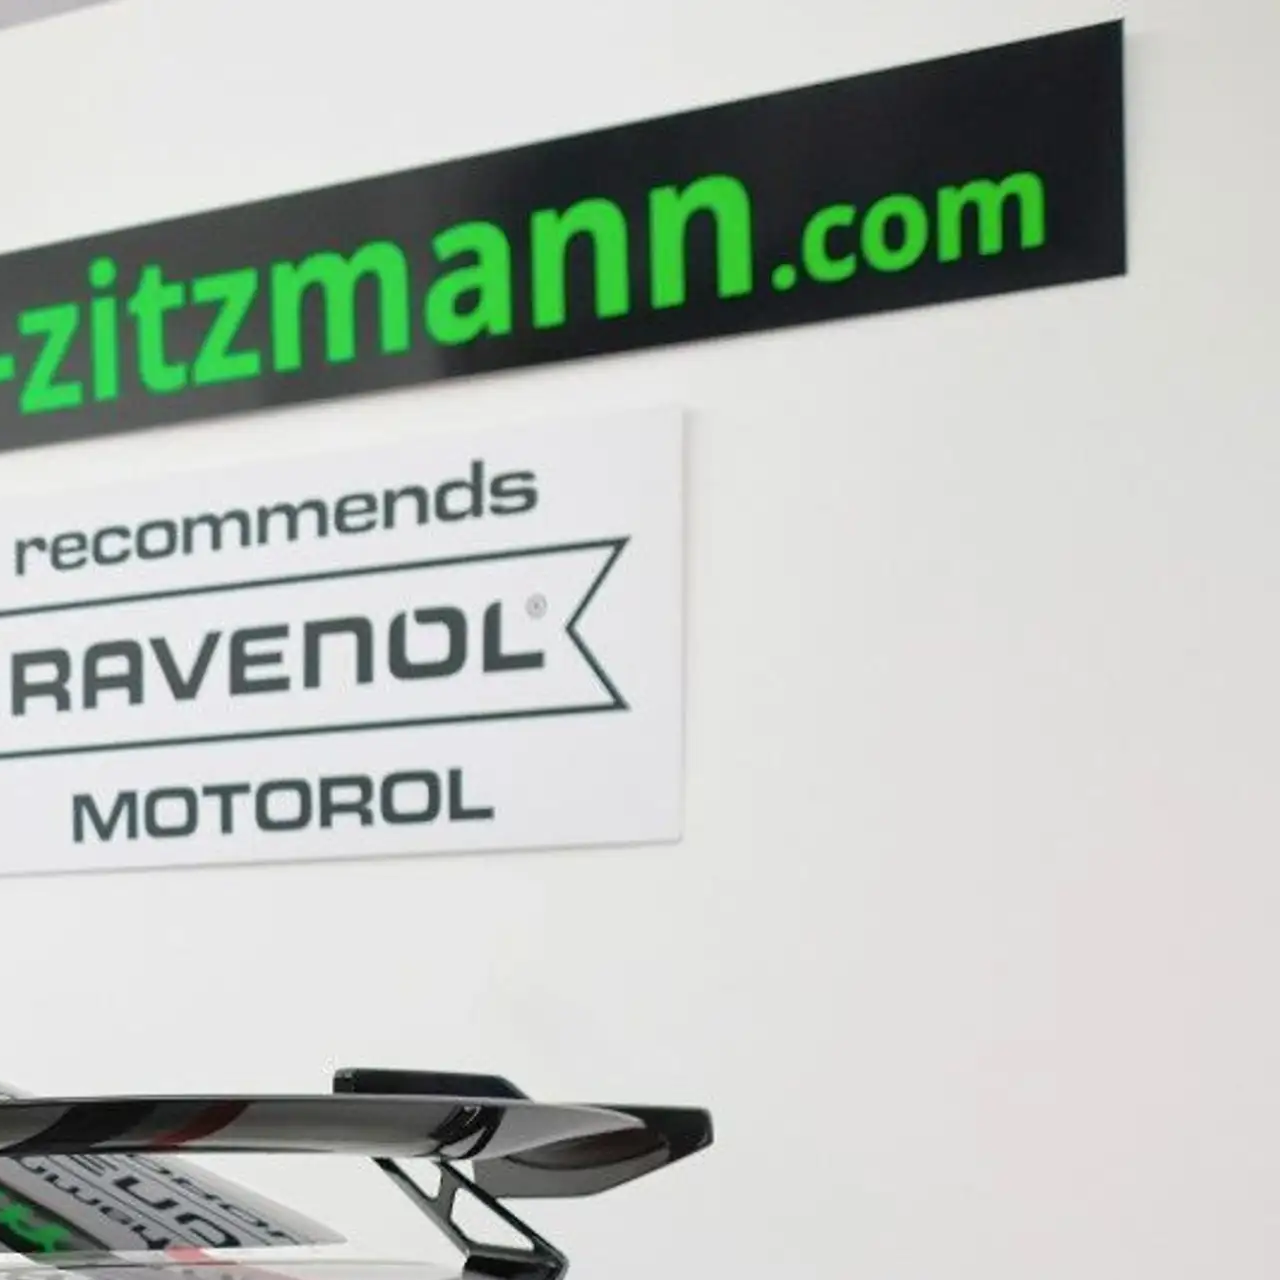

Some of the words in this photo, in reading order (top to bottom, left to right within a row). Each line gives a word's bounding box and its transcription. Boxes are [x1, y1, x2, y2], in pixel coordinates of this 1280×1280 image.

[15, 460, 539, 577] recommends
[12, 601, 545, 717] RAVENOL
[72, 767, 494, 843] MOTOROL
